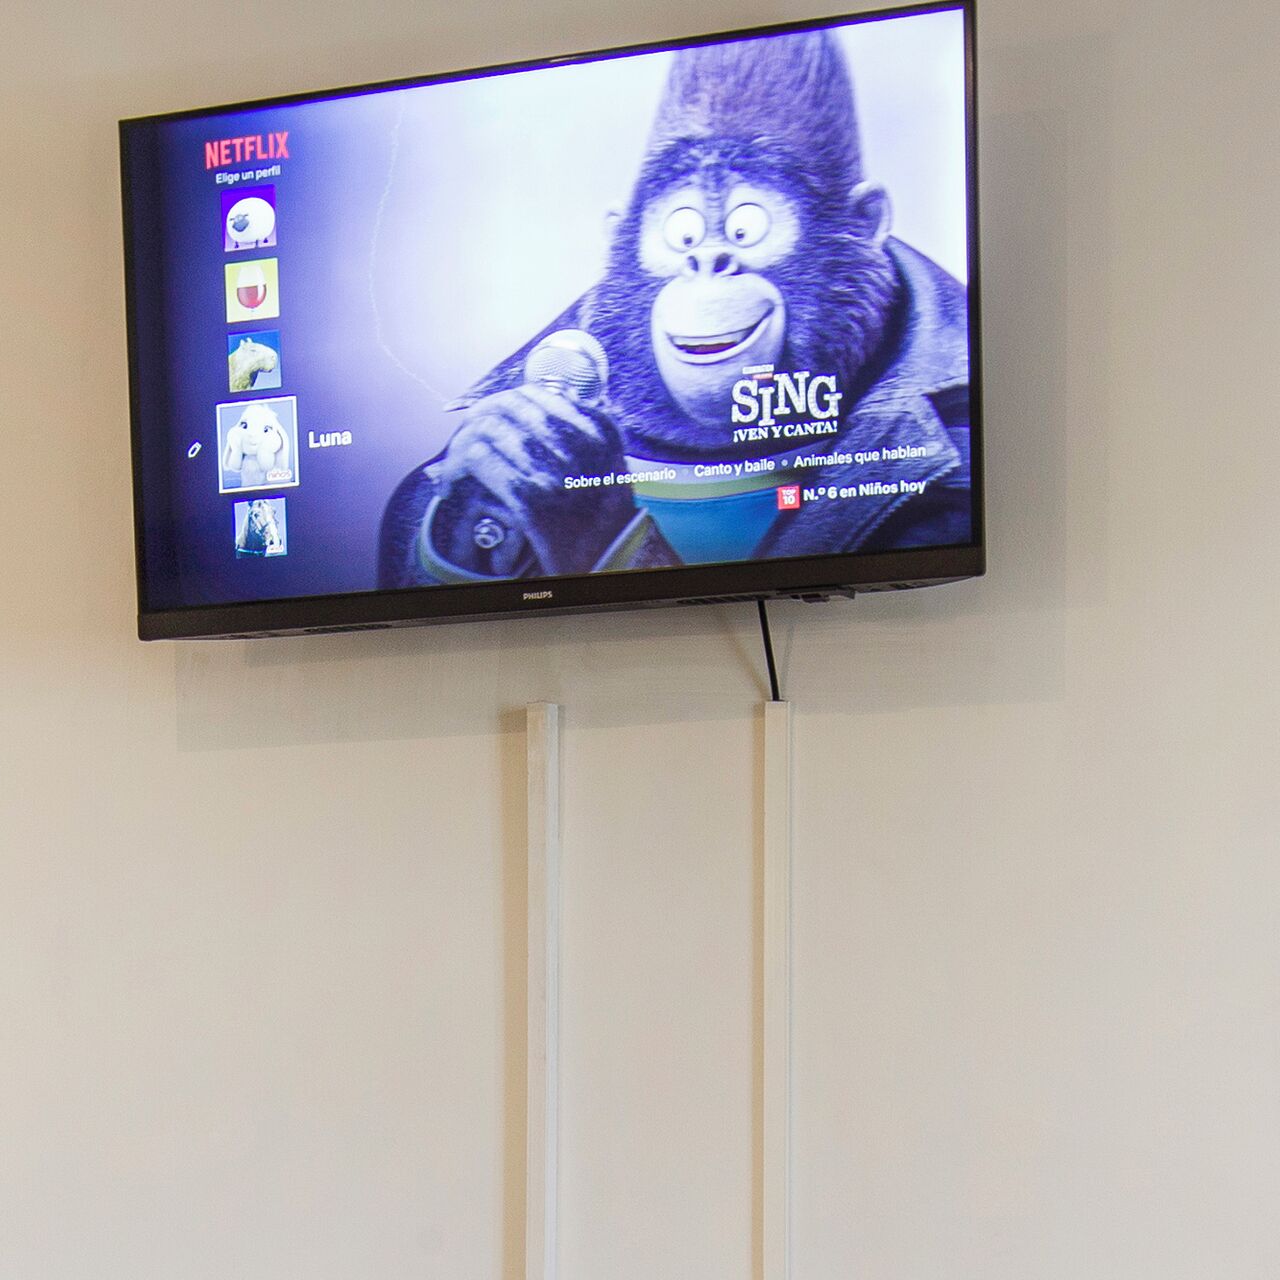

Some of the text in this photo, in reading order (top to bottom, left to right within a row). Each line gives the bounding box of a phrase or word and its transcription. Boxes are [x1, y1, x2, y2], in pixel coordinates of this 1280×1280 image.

[205, 131, 289, 170] NETFLIX
[215, 164, 281, 185] Elige un perfil
[731, 370, 843, 427] SING
[308, 430, 353, 449] Luna
[733, 420, 838, 443] ¡VEN Y CANTA!
[564, 444, 927, 490] Sobre el escenario Canto y baile Animales que hablan
[783, 495, 796, 505] 10
[827, 486, 838, 500] 6
[839, 486, 857, 499] en
[858, 481, 899, 496] Niños
[899, 479, 927, 495] hoy
[522, 590, 553, 600] PHILIPS
